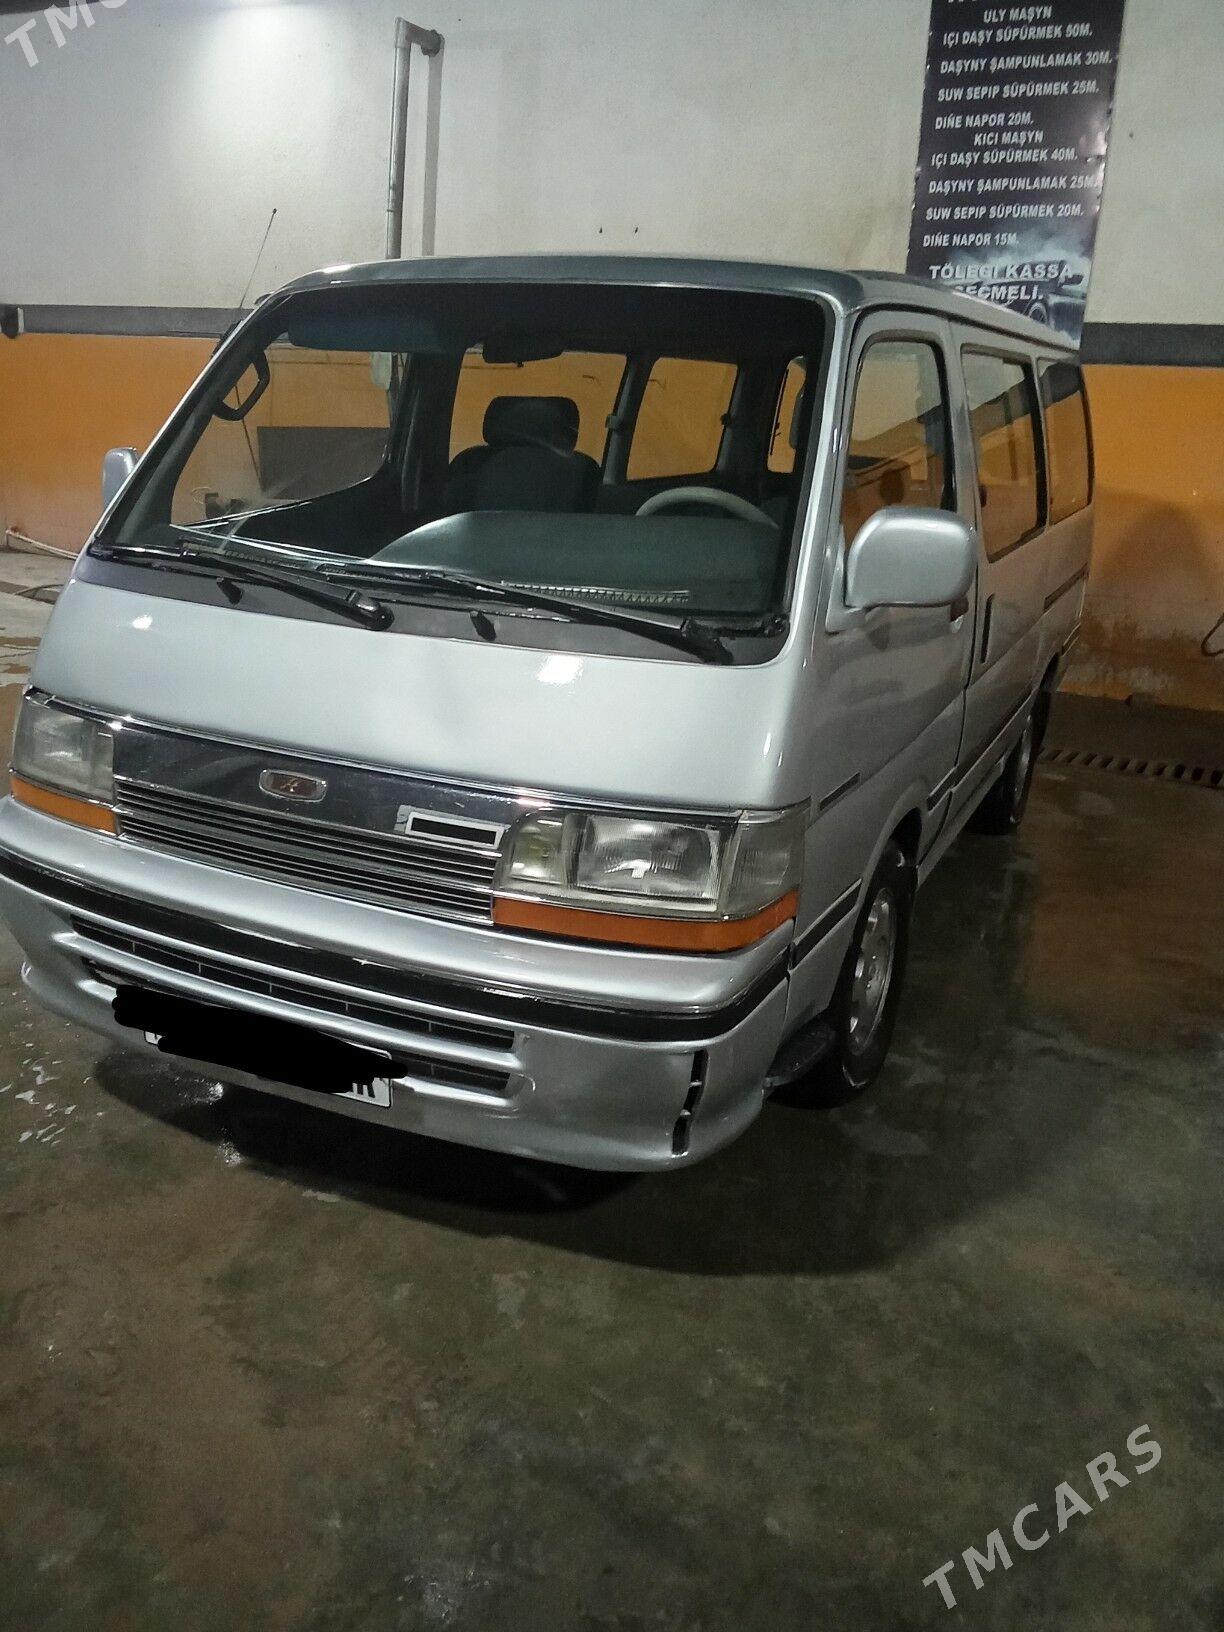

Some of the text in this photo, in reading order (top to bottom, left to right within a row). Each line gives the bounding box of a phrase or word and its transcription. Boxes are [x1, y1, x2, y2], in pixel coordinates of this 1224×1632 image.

[983, 6, 1053, 24] ULY MAŞYN
[962, 30, 993, 47] DAŞY
[995, 24, 1062, 42] SÜPÜRMEK
[1065, 22, 1093, 38] 50M.
[940, 50, 1112, 76] DAŞYNY ŞAMPUNLAMAK 30M.
[938, 80, 1100, 102] SUW SEPIP SÜPÜRMEK 25M.
[965, 112, 1005, 127] NAPOR
[1008, 111, 1034, 126] 20M.
[1001, 130, 1044, 147] MAŞYN
[949, 152, 980, 169] DAŞY
[982, 147, 1048, 165] SÜPÜRMEK
[1051, 147, 1078, 162] 40M.
[928, 179, 974, 198] DAŞYNY
[976, 175, 1067, 195] ŞAMPUNLAMAK
[925, 200, 1084, 221] SUW SEPIP SÜPÜRMEK 20M.
[951, 233, 991, 247] NAPOR
[993, 231, 1020, 246] 15M.
[1005, 262, 1074, 279] KASSA
